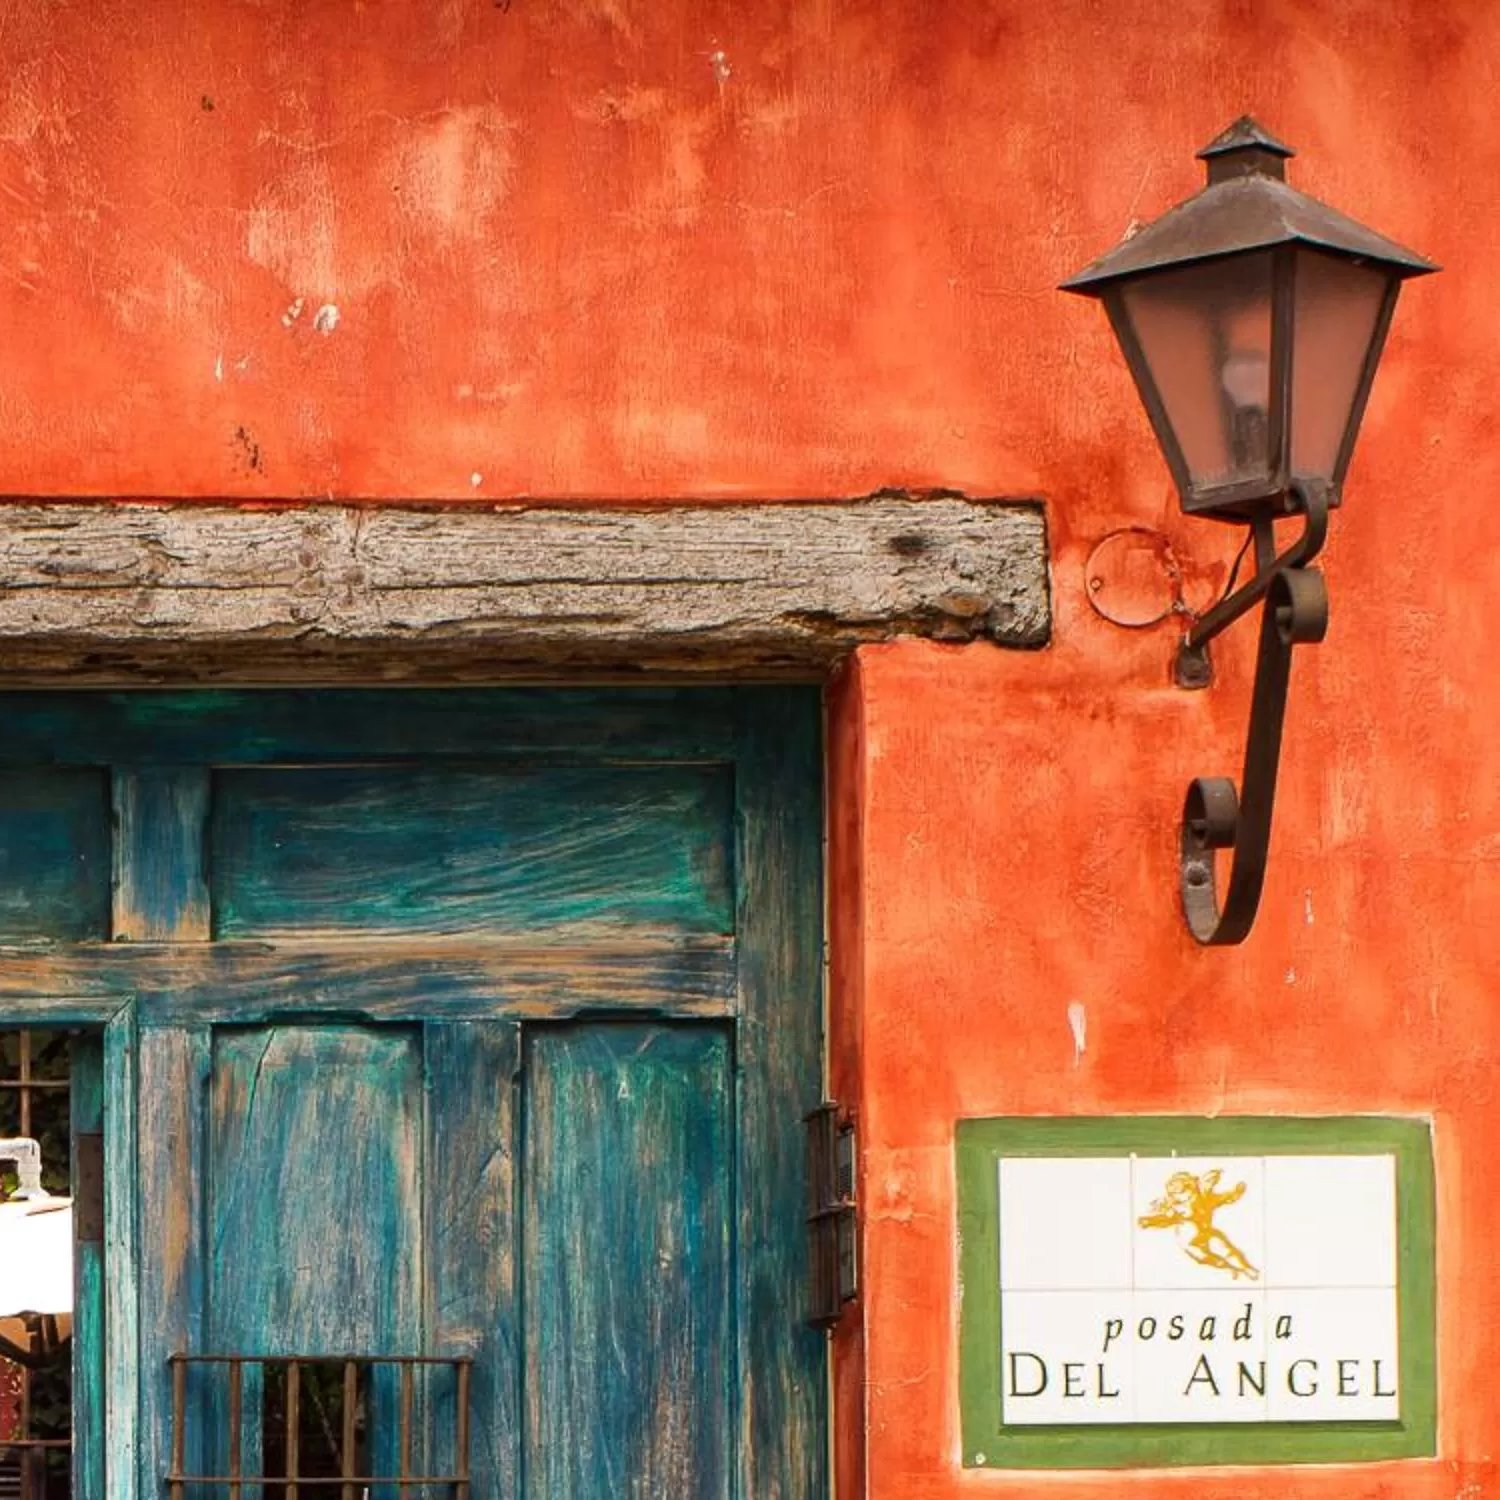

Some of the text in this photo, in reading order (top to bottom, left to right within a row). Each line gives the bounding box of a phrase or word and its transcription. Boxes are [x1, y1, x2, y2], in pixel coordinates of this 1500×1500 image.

[1103, 1303, 1292, 1352] posada
[1009, 1352, 1396, 1398] DEL ANGEL
